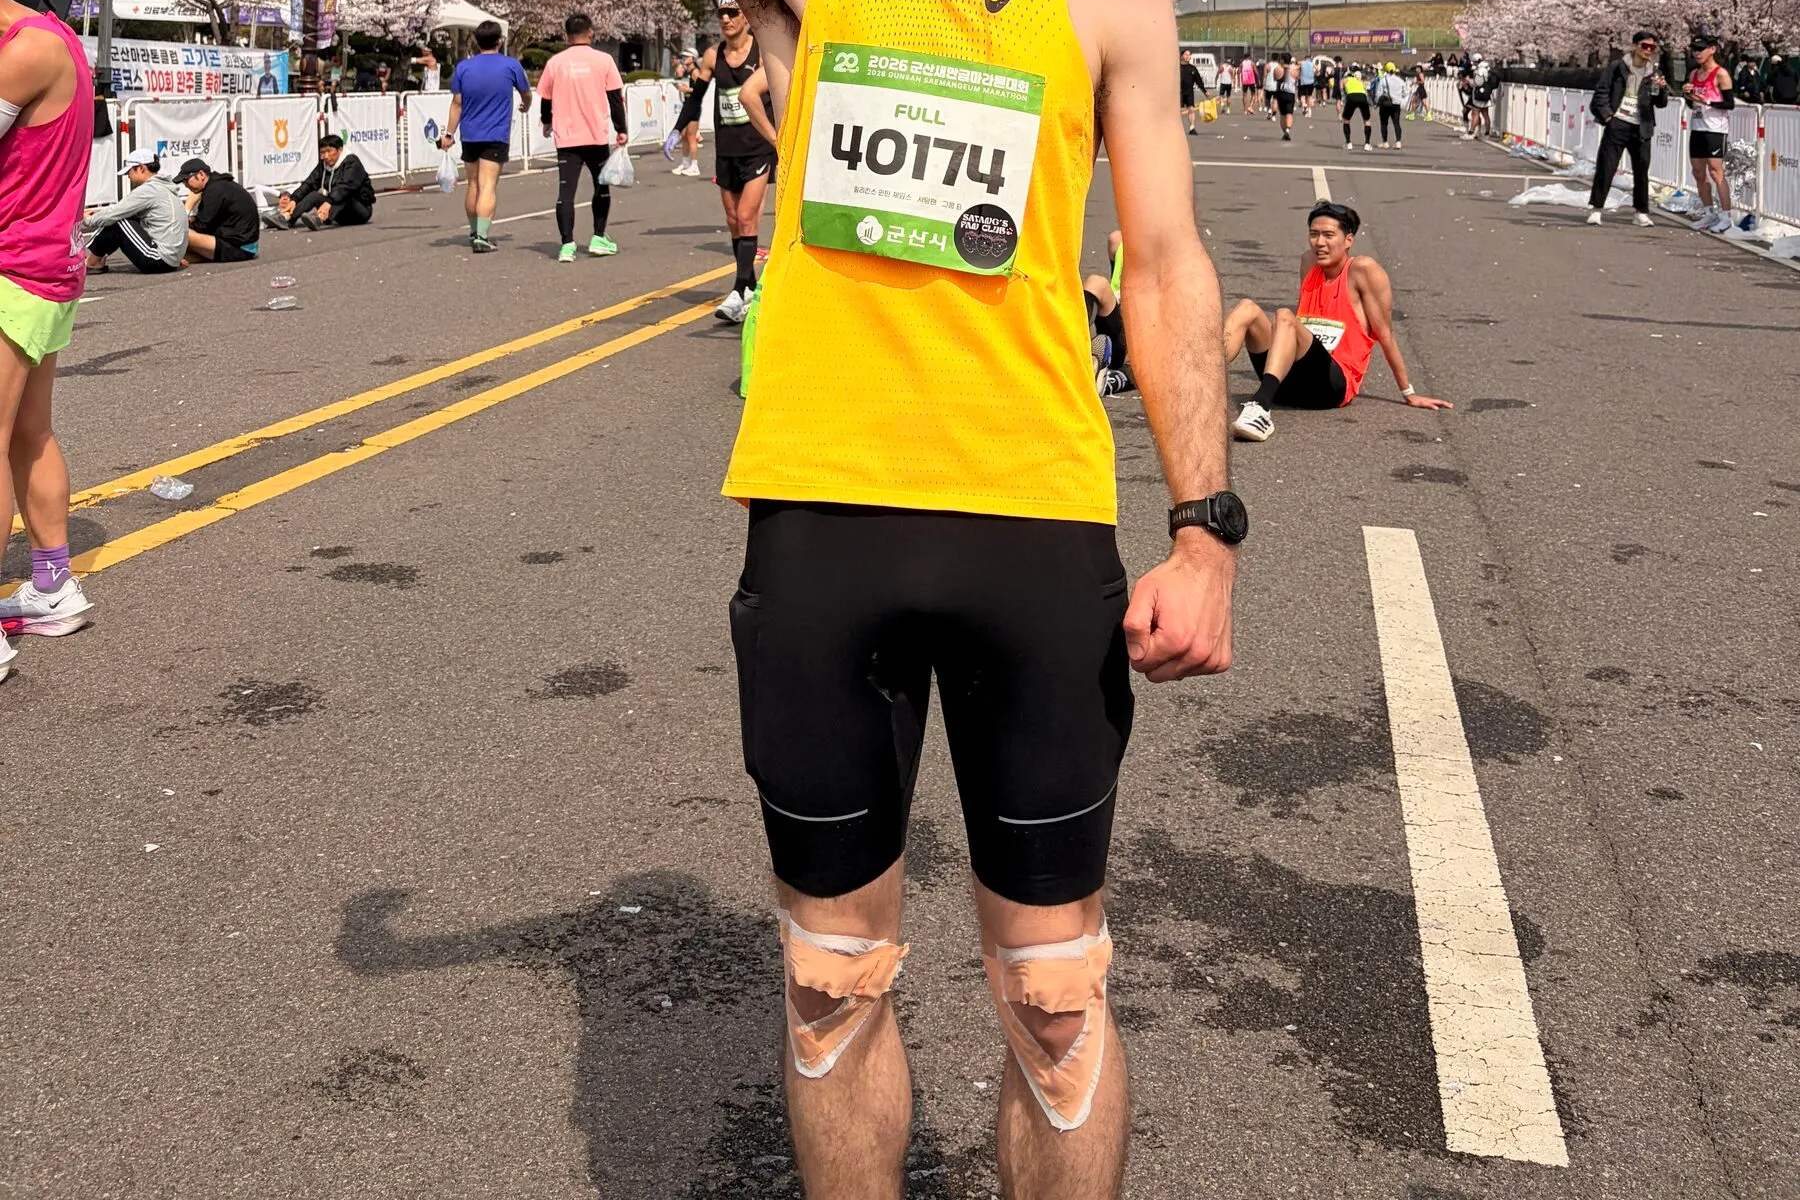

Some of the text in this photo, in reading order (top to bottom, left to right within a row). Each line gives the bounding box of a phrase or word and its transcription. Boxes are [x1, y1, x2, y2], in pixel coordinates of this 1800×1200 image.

[111, 46, 179, 65] 군산마라톤클럽
[112, 68, 253, 95] 풀코스 100회 완주를 축하드립니다
[867, 69, 1029, 102] 2026 GUNSAN SAEMANGEUM MARATHON
[868, 55, 1029, 94] 2026 군산새만금마라톤대회
[894, 104, 946, 126] FULL
[350, 128, 389, 143] HD현대중공업
[170, 138, 211, 158] 전북은행
[831, 123, 1006, 195] 40174
[960, 221, 1006, 235] FAN CLUB
[962, 213, 1009, 227] SATANG'S
[886, 224, 947, 252] 군산시
